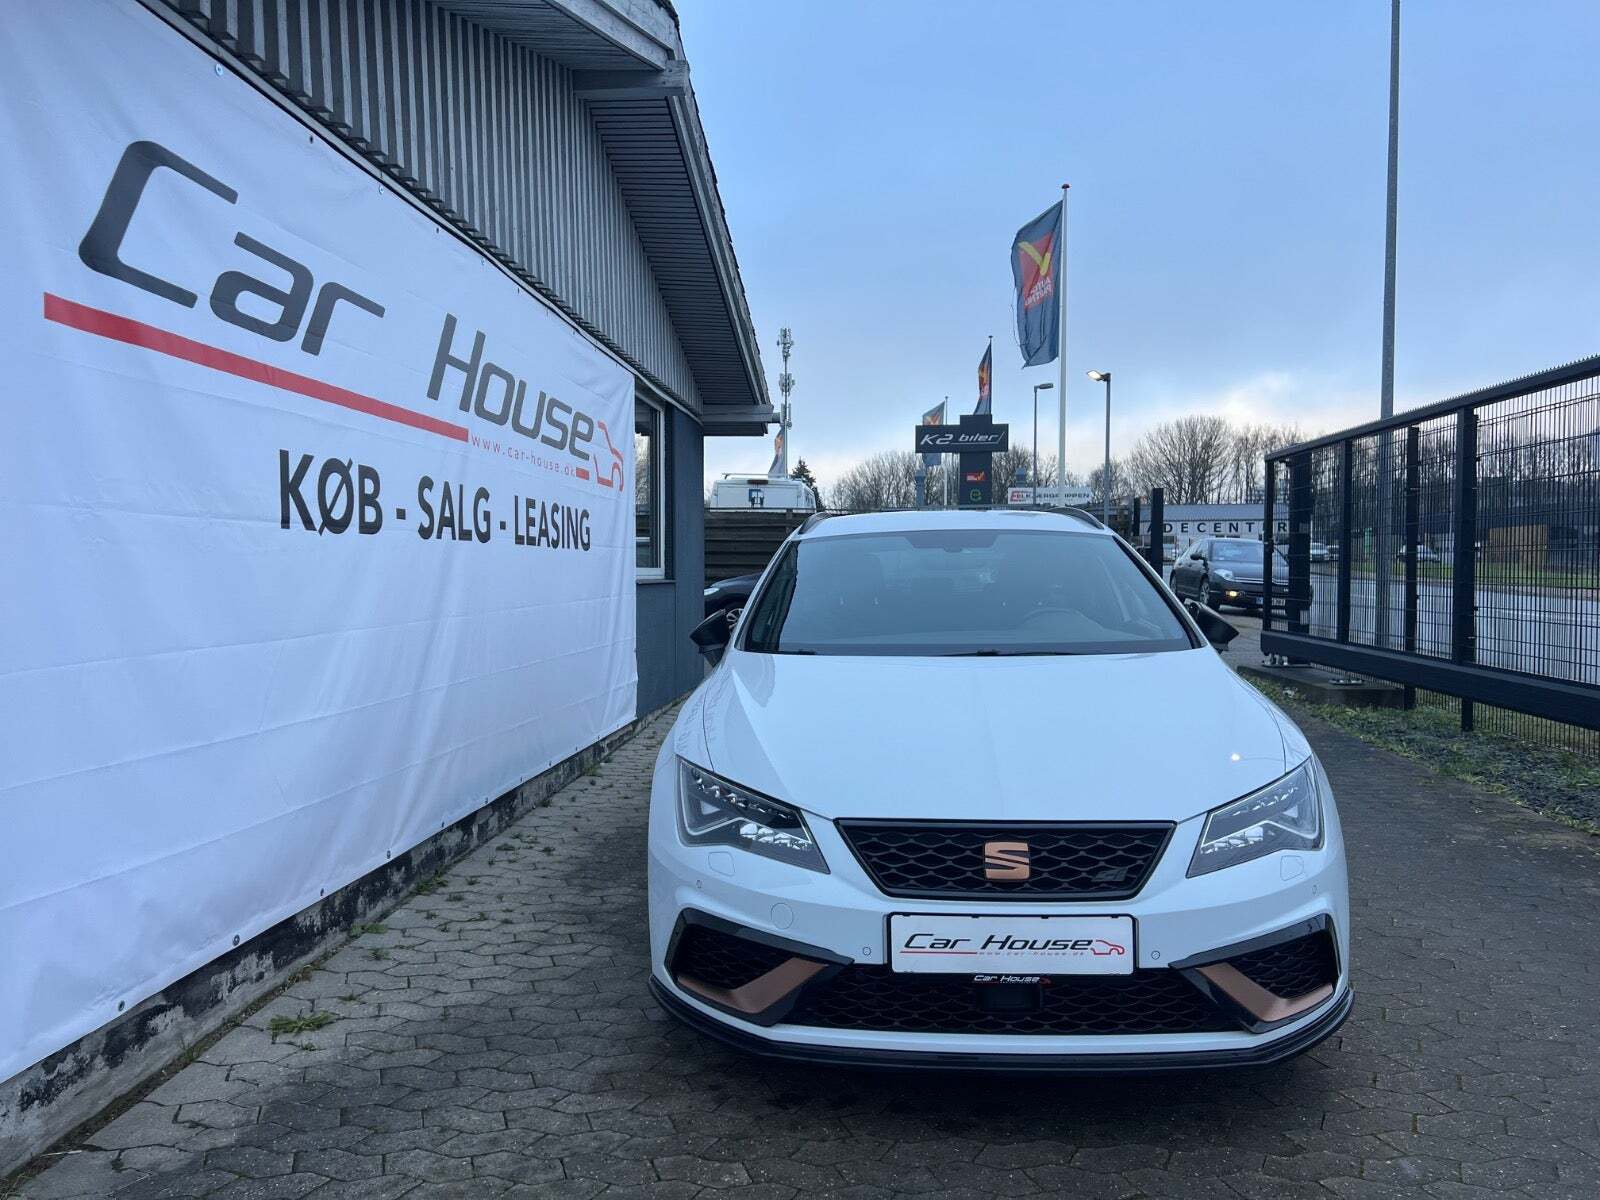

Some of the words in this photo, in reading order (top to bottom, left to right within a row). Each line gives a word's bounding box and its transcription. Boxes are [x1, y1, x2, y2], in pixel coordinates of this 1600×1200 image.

[79, 140, 386, 356] Car
[427, 312, 594, 462] House
[920, 433, 954, 446] K2
[471, 434, 575, 476] www.car-house.dk
[279, 448, 382, 537] KØB
[417, 475, 491, 543] SALG
[514, 495, 591, 552] LEASING
[904, 933, 971, 949] Car
[981, 935, 1093, 951] House
[974, 974, 998, 982] Car
[1000, 975, 1040, 983] House
